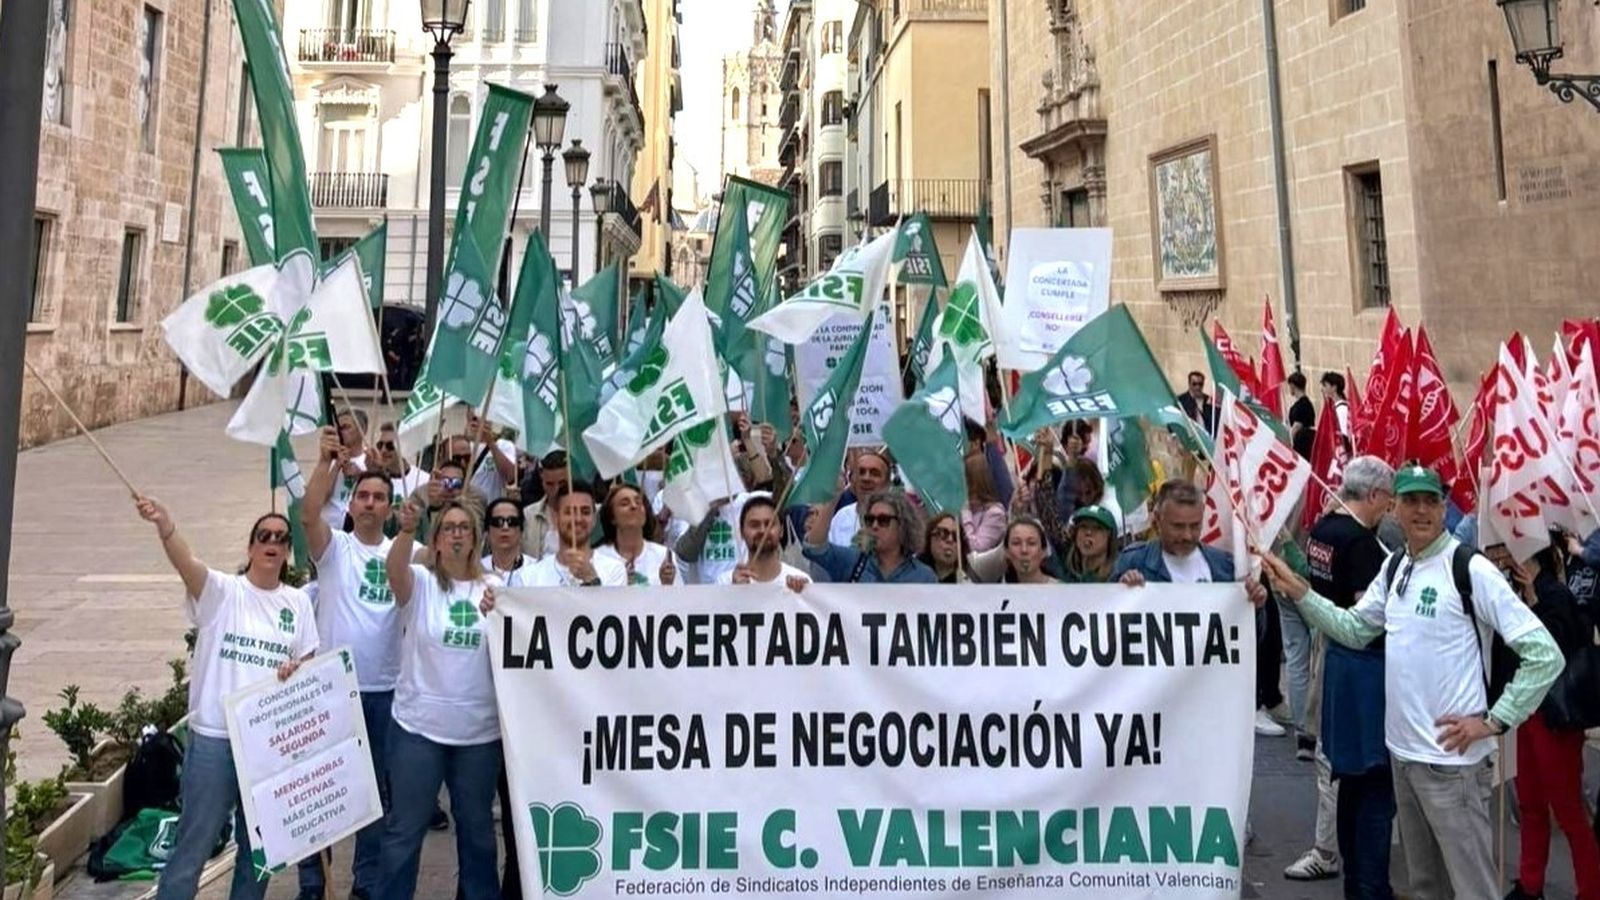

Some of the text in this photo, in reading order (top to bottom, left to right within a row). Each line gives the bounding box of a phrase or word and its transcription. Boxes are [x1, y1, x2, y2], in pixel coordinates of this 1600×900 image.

[1033, 276, 1088, 288] CONCERTADA
[1057, 266, 1068, 274] LA
[1041, 288, 1075, 299] CUMPLE
[853, 423, 873, 434] SIE
[706, 547, 735, 560] FSIE
[359, 583, 394, 603] FSIE
[443, 631, 481, 647] FSIE
[502, 600, 1240, 670] LA CONCERTADA TAMBIÉN CUENTA:
[249, 681, 333, 727] PROFESIONALES DE
[275, 705, 315, 729] PRIMERA
[269, 710, 331, 747] SALARIOS DE
[279, 728, 326, 756] SEGUNDA
[582, 700, 1161, 785] ¡MESA DE NEGOCIACIÓN YA!
[273, 756, 345, 799] MENOS HORAS
[288, 778, 335, 808] LECTIVAS
[306, 786, 348, 814] CALIDAD
[290, 804, 346, 839] EDUCATIVA
[611, 806, 1239, 871] FSIE C. VALENCIANA
[615, 871, 1238, 895] Federación de Sindicatos Independientes de Enseñanza Comunitat Valencian
